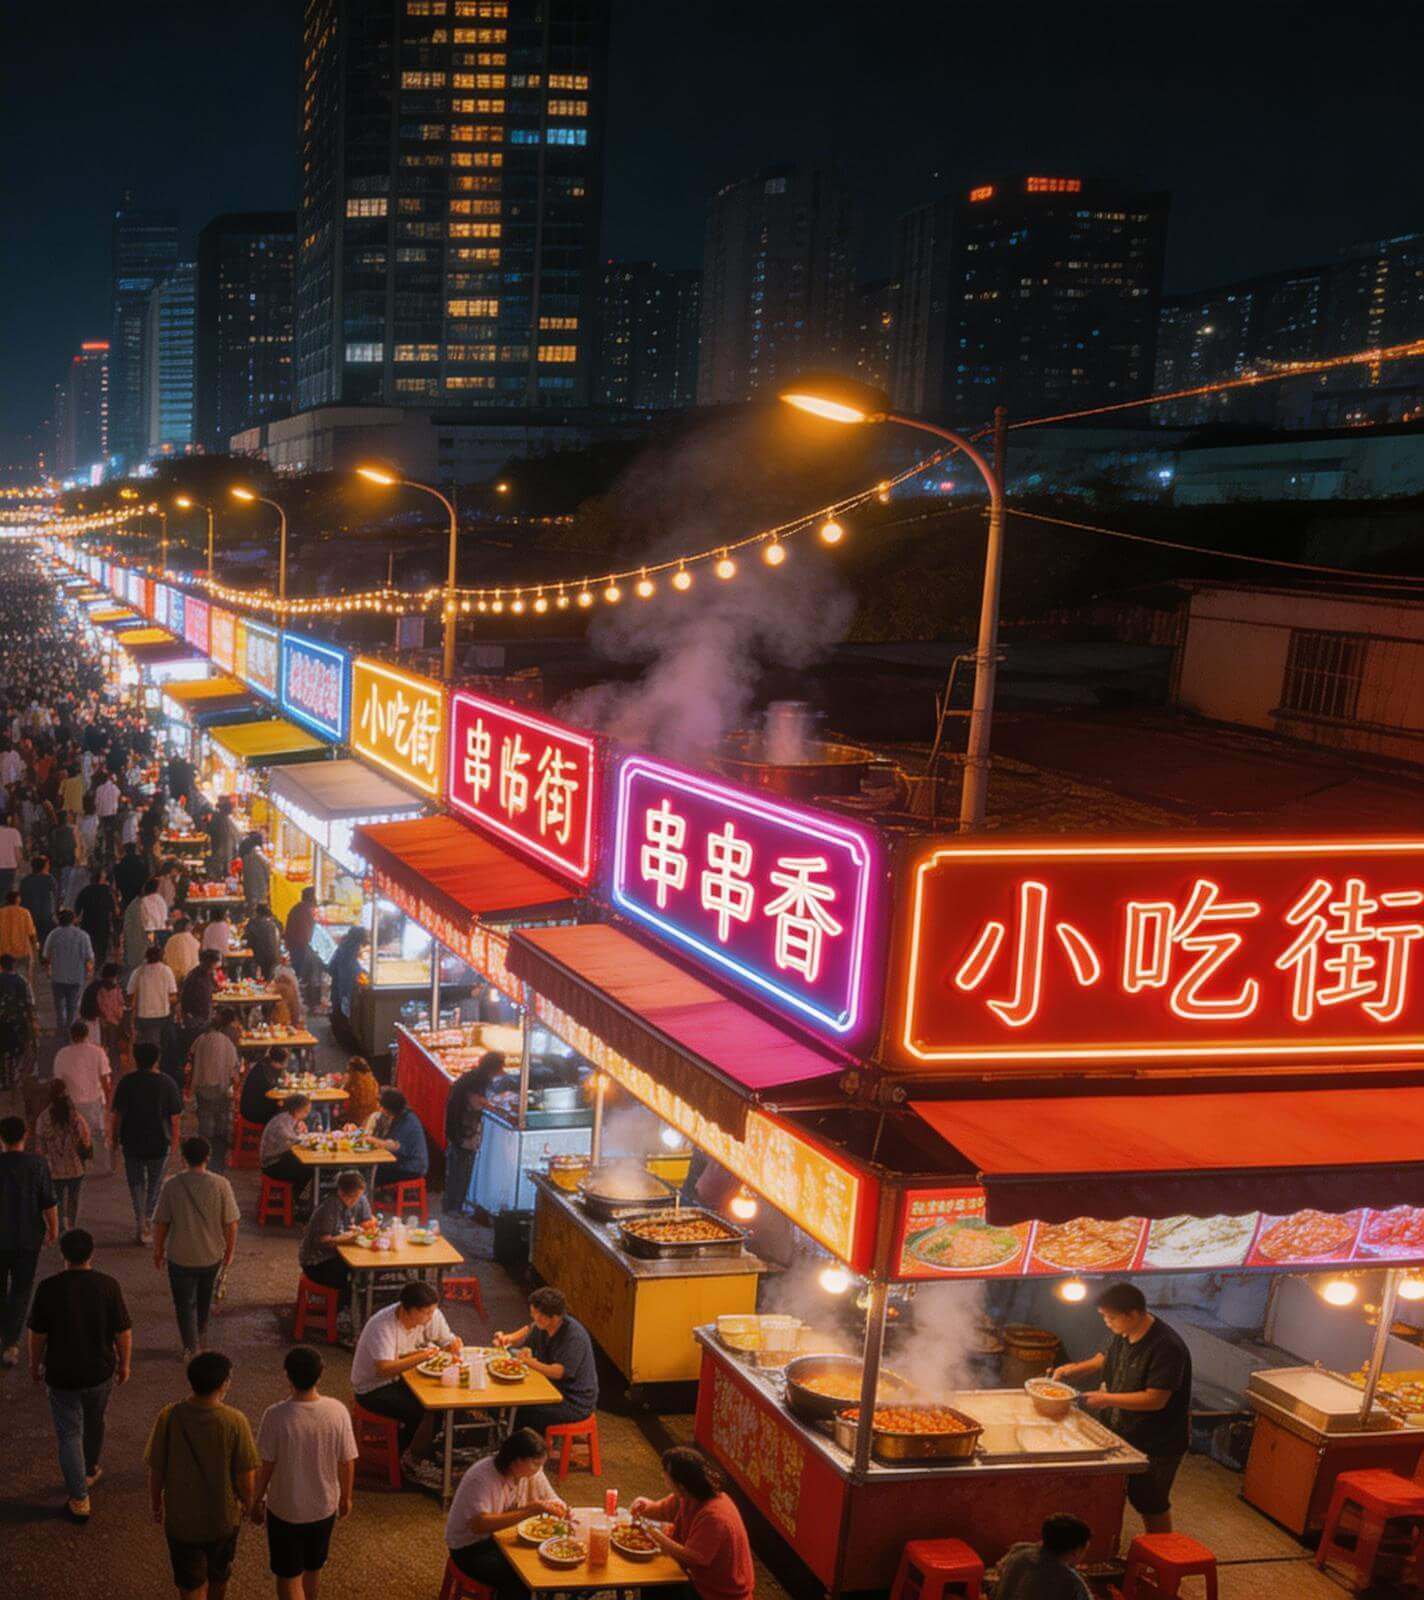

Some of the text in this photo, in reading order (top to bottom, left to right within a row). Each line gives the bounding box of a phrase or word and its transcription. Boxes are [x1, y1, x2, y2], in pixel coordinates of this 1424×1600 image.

[641, 799, 843, 983] 串串香
[954, 878, 1424, 1027] 小吃街
